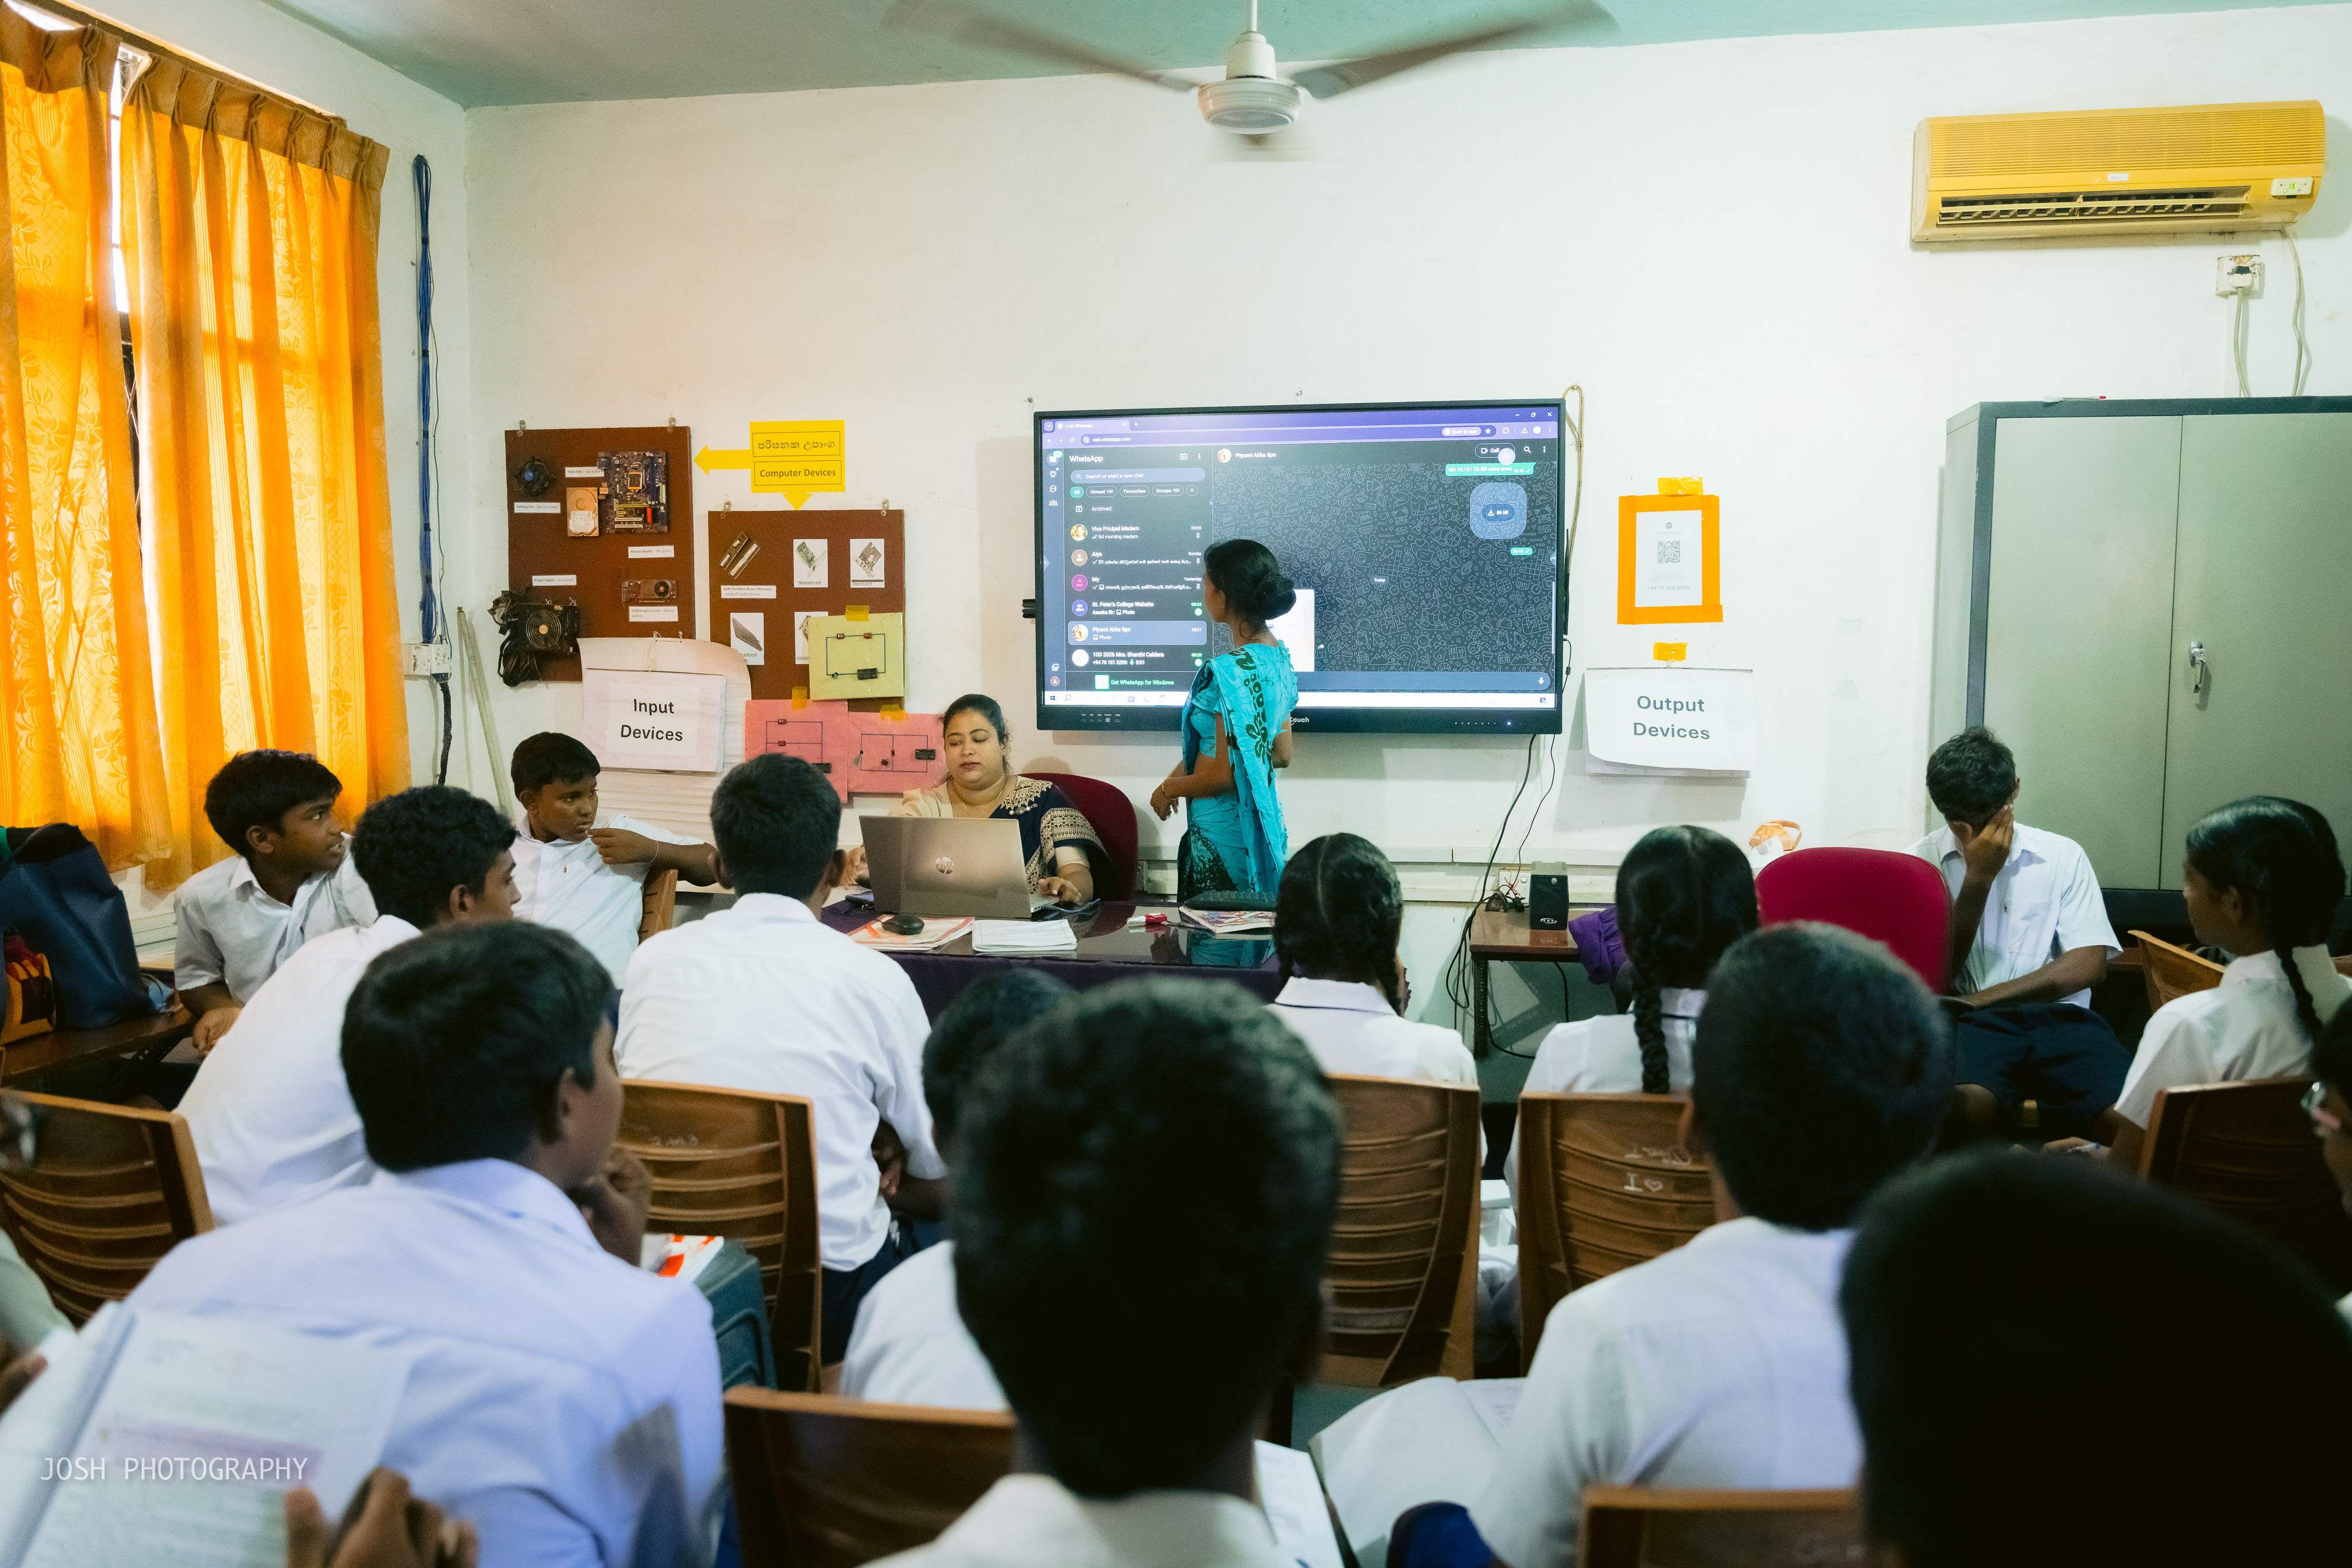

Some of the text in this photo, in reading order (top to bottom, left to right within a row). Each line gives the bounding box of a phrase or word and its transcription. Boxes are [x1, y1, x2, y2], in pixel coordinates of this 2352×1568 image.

[760, 470, 802, 478] Computer
[633, 698, 674, 716] Input
[1637, 696, 1705, 714] Output
[620, 724, 683, 741] Devices
[1633, 722, 1710, 740] Devices
